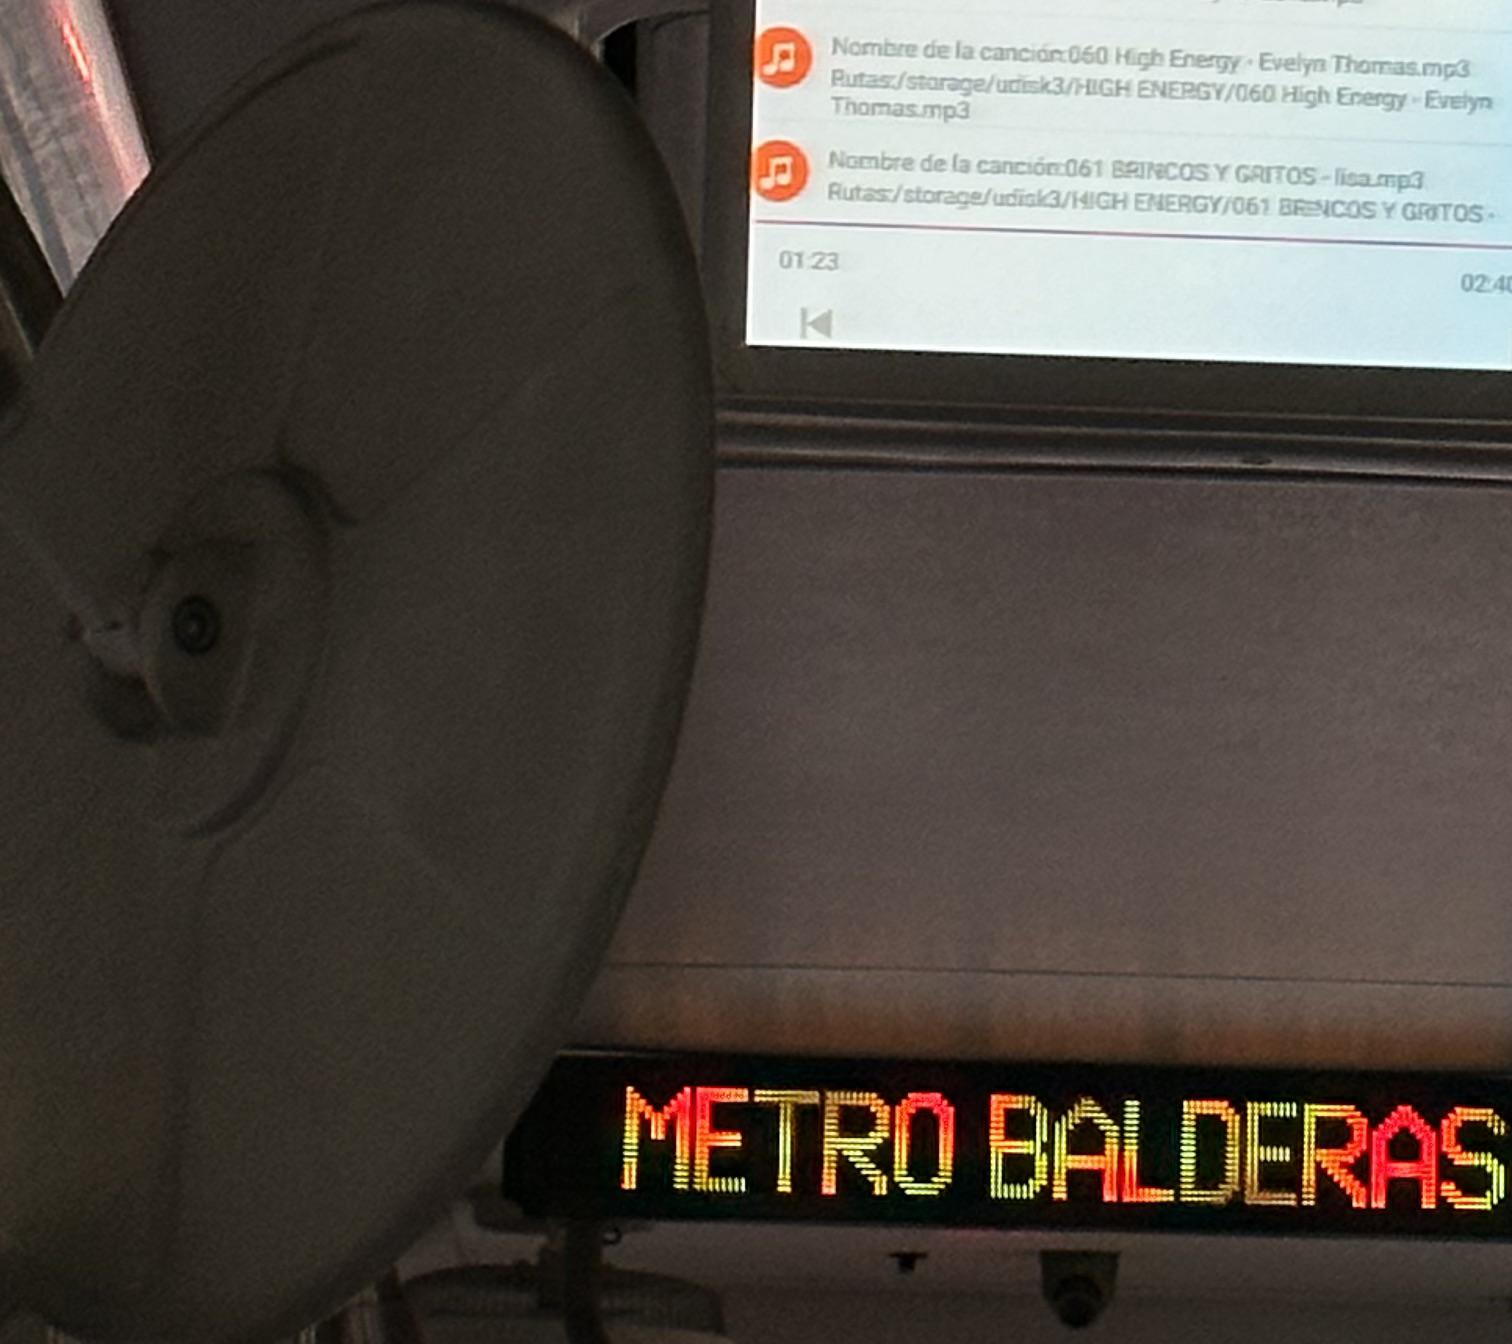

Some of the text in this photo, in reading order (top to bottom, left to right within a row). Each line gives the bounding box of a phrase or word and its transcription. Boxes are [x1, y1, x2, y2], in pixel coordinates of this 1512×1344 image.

[832, 37, 917, 58] Nombre
[923, 40, 950, 60] de
[955, 41, 974, 61] la
[1115, 47, 1164, 71] High
[1169, 50, 1240, 74] Energy
[1259, 52, 1327, 76] Evelyn
[1332, 54, 1471, 81] Thomas.mp3
[831, 96, 971, 123] Thomas.mp3
[1281, 86, 1330, 109] High
[1337, 87, 1406, 112] Energy
[1425, 90, 1494, 115] Evelyn
[828, 151, 914, 173] Nombre
[920, 153, 947, 174] de
[952, 154, 971, 175] la
[1112, 160, 1209, 182] BRINCOS
[1213, 164, 1230, 181] Y
[1235, 164, 1316, 185] GRITOS
[1279, 197, 1376, 219] BRINCOS
[1383, 201, 1397, 219] Y
[1402, 201, 1483, 223] GRITOS
[779, 250, 839, 272] 01:23
[622, 1085, 1506, 1211] METRO BALDERAS
